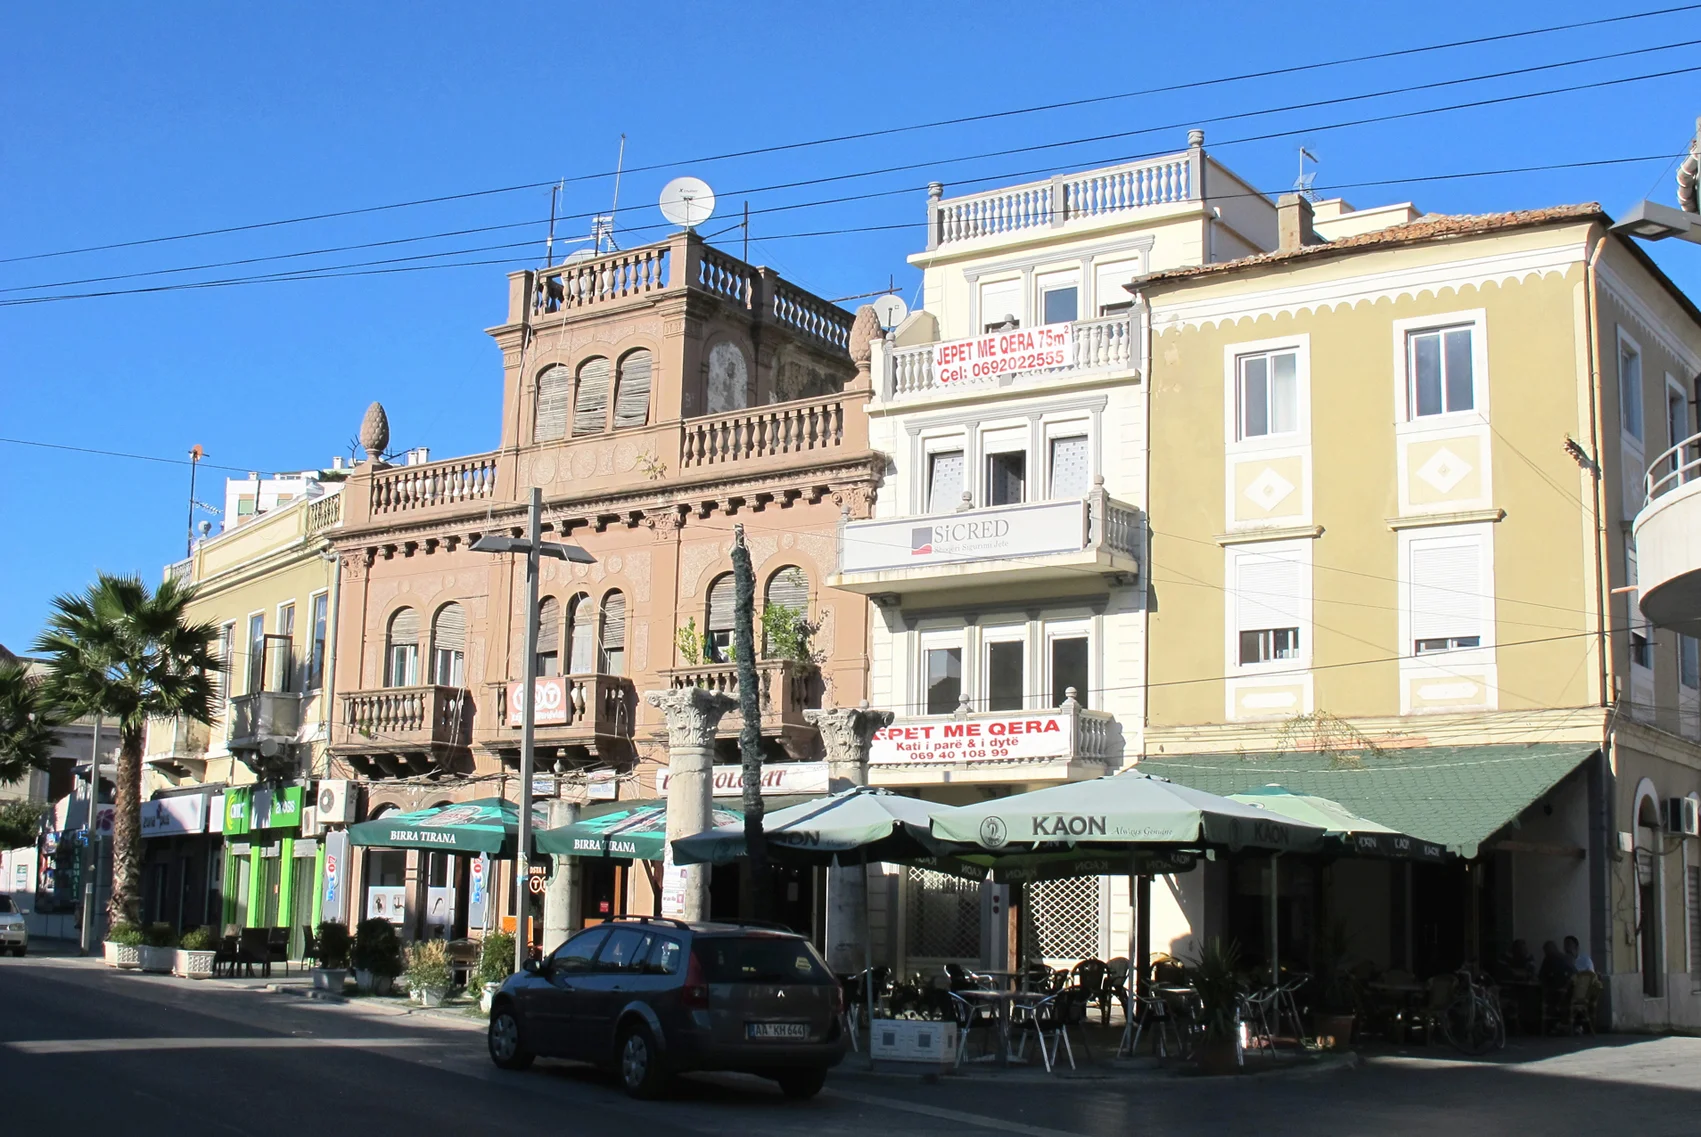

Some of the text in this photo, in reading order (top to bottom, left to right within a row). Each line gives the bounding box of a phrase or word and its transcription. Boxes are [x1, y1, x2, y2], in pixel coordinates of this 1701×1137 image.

[937, 343, 973, 366] JEPET
[978, 338, 996, 357] ME
[1001, 332, 1034, 354] QERA
[940, 350, 1065, 383] Cel: 0692022555
[934, 519, 1009, 543] SiCRED
[944, 724, 981, 737] ME
[988, 720, 1060, 736] QERA
[896, 742, 921, 751] Kati
[934, 740, 962, 750] parë
[967, 738, 976, 748] &
[989, 737, 1019, 748] dytë
[910, 748, 1009, 761] 069 40 108 99
[1032, 815, 1107, 836] KAON
[1254, 822, 1289, 845] KAON
[390, 831, 456, 844] BIRRA TIRANA
[574, 839, 601, 850] BIRRA
